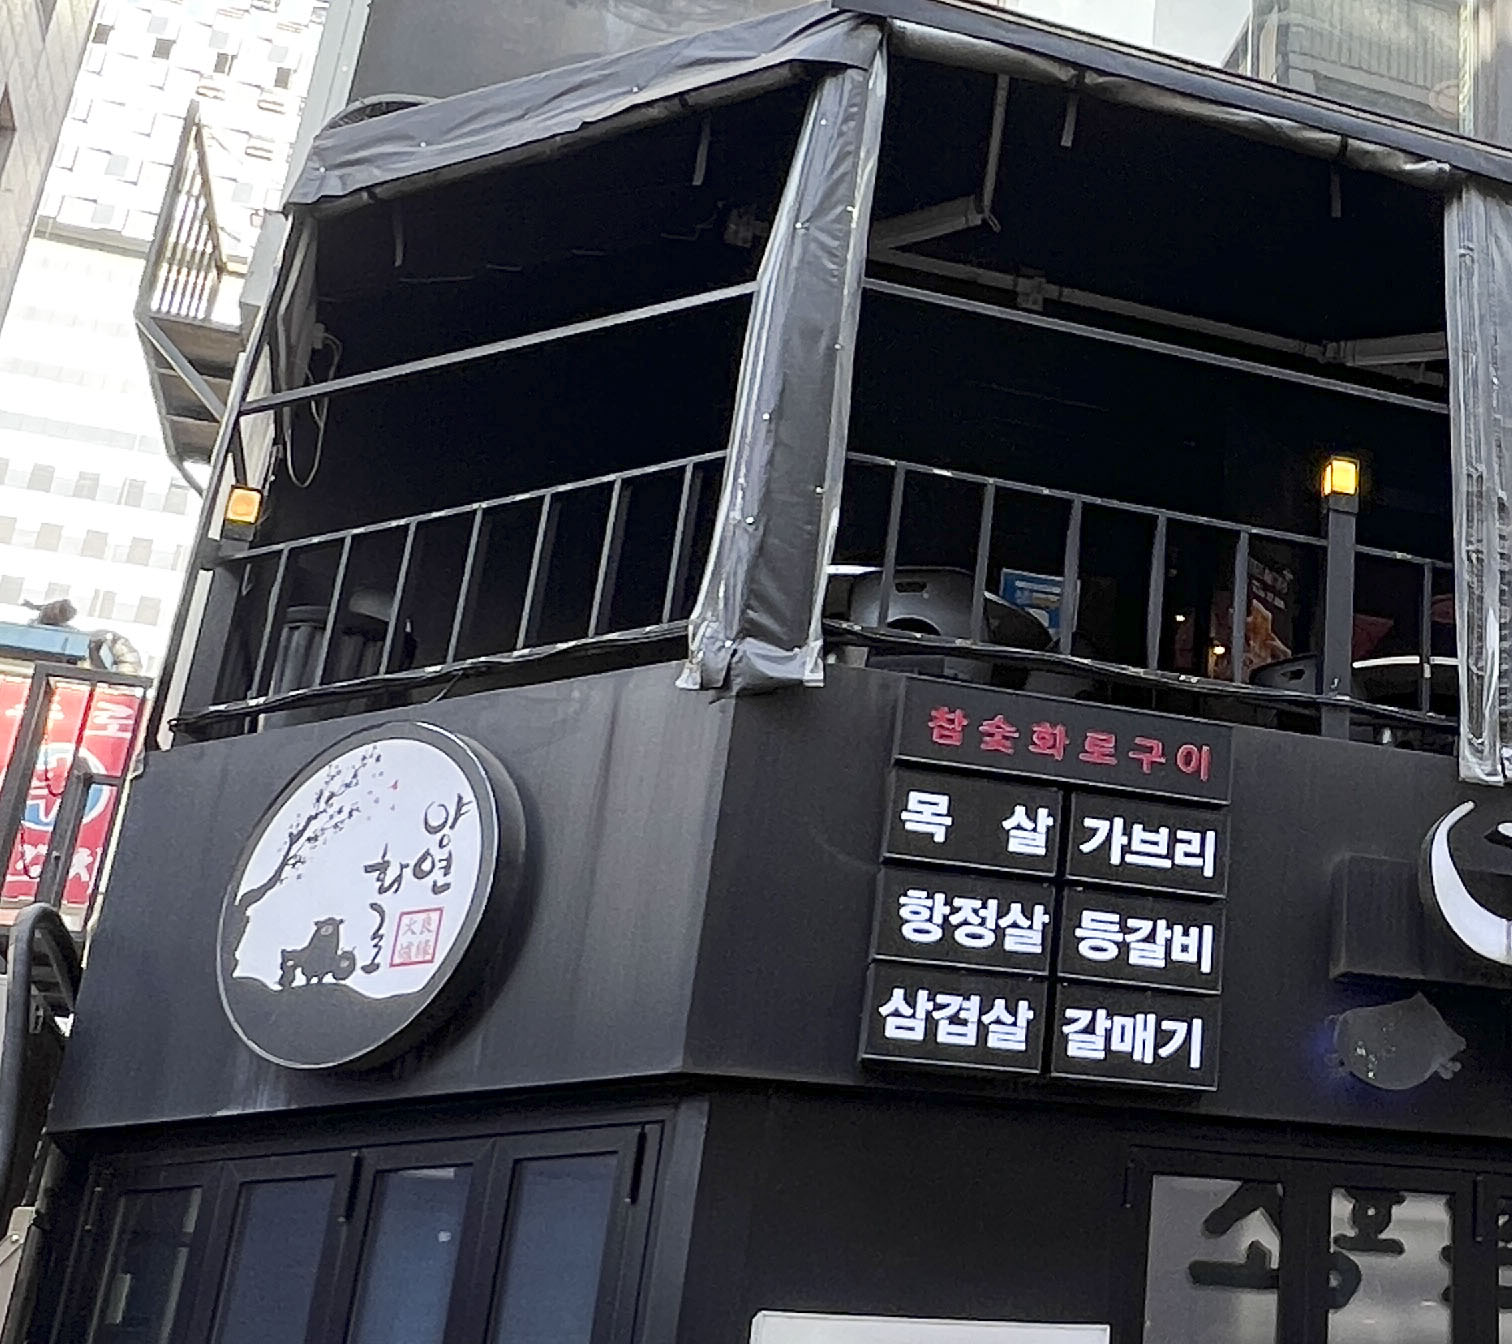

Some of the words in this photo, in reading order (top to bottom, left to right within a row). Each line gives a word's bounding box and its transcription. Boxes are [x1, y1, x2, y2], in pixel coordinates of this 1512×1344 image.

[1079, 816, 1216, 878] 가브리
[898, 888, 1050, 955] 항정살
[1074, 909, 1214, 974] 등갈비
[878, 987, 1035, 1052] 삼겹살
[1061, 1007, 1204, 1069] 갈매기
